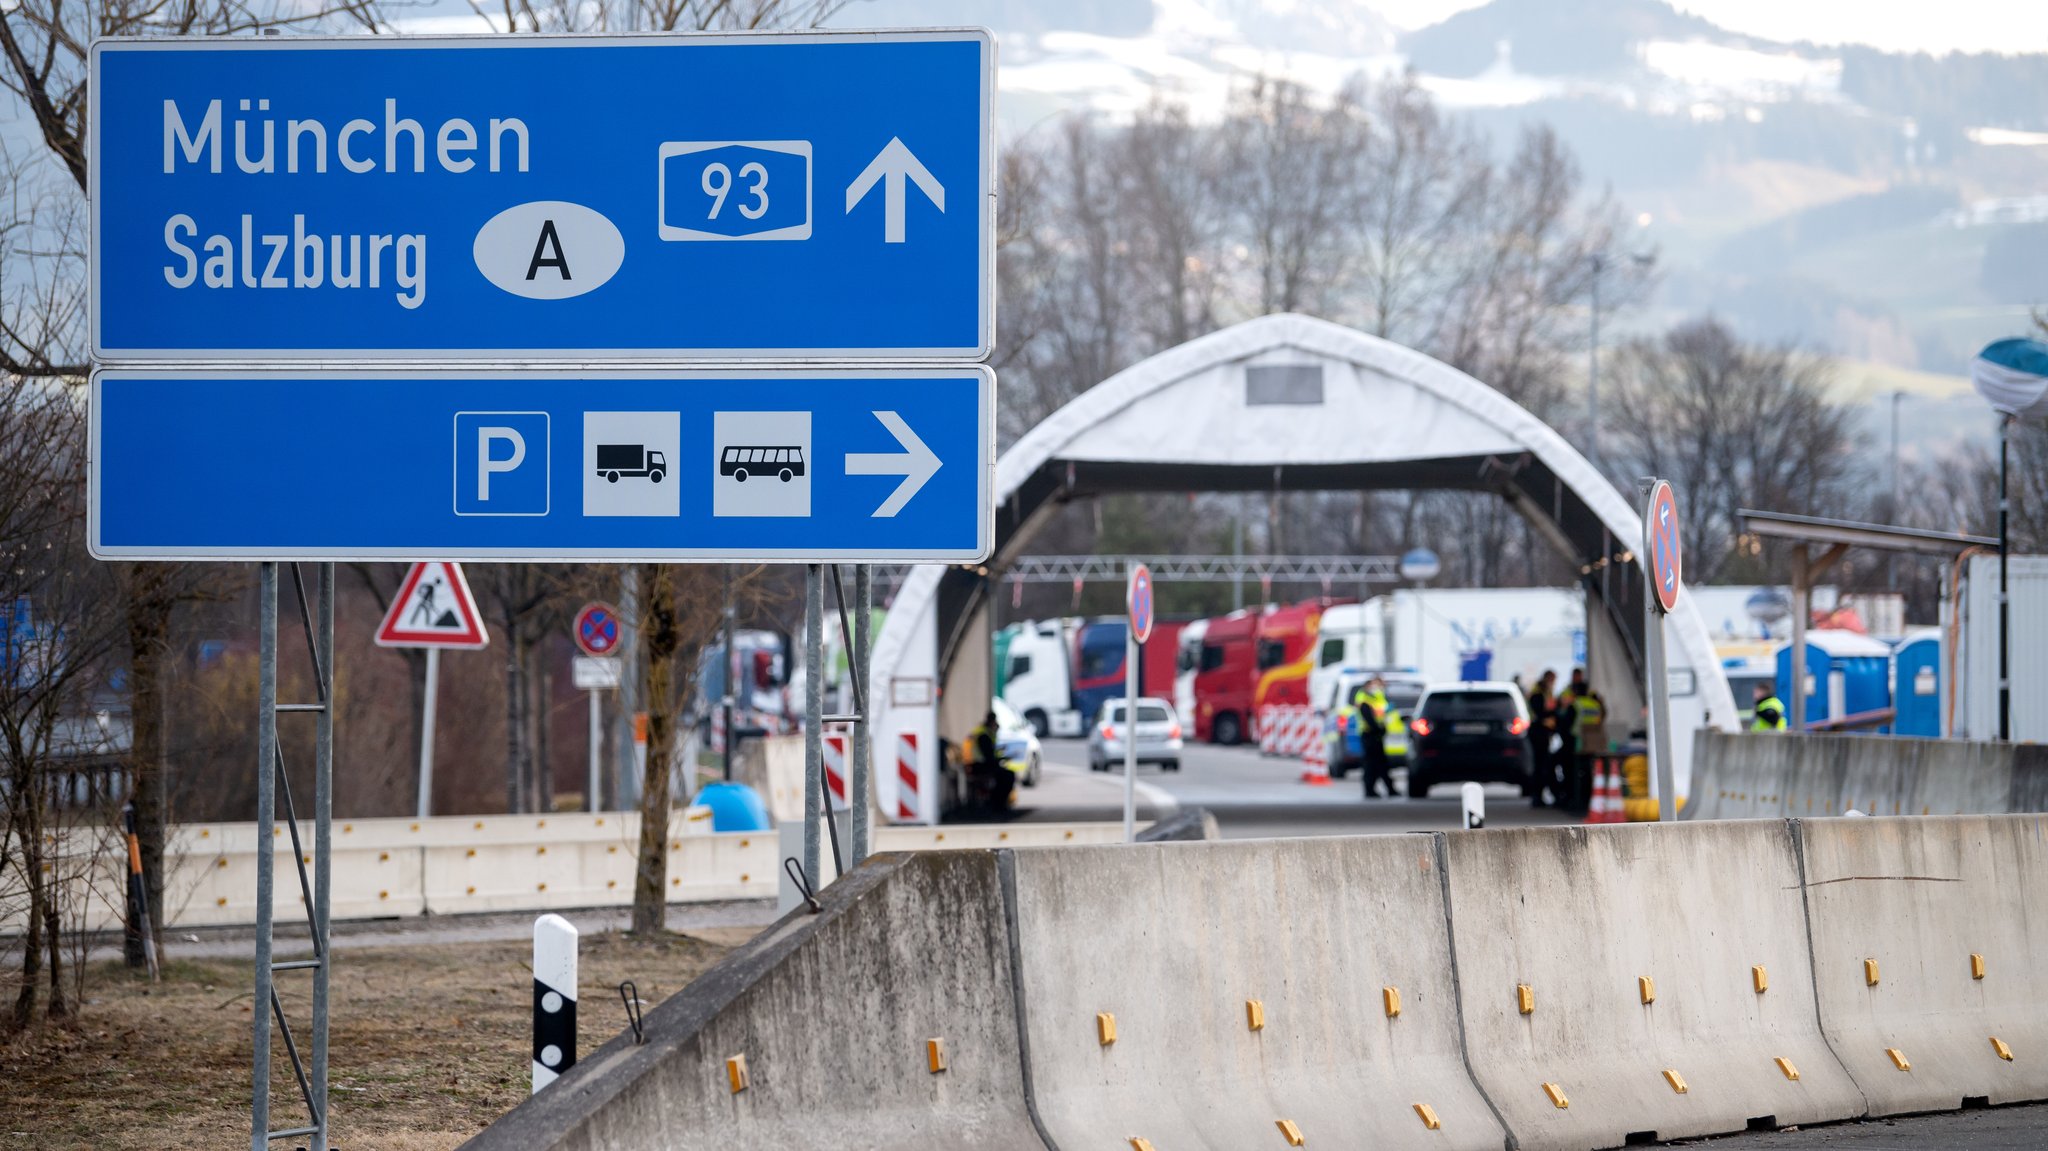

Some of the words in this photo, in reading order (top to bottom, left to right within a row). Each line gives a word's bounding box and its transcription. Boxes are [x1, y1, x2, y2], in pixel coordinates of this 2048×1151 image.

[163, 98, 529, 174] München
[701, 162, 769, 220] 93
[164, 213, 426, 310] Salzburg
[526, 220, 571, 280] A
[478, 426, 526, 501] P
